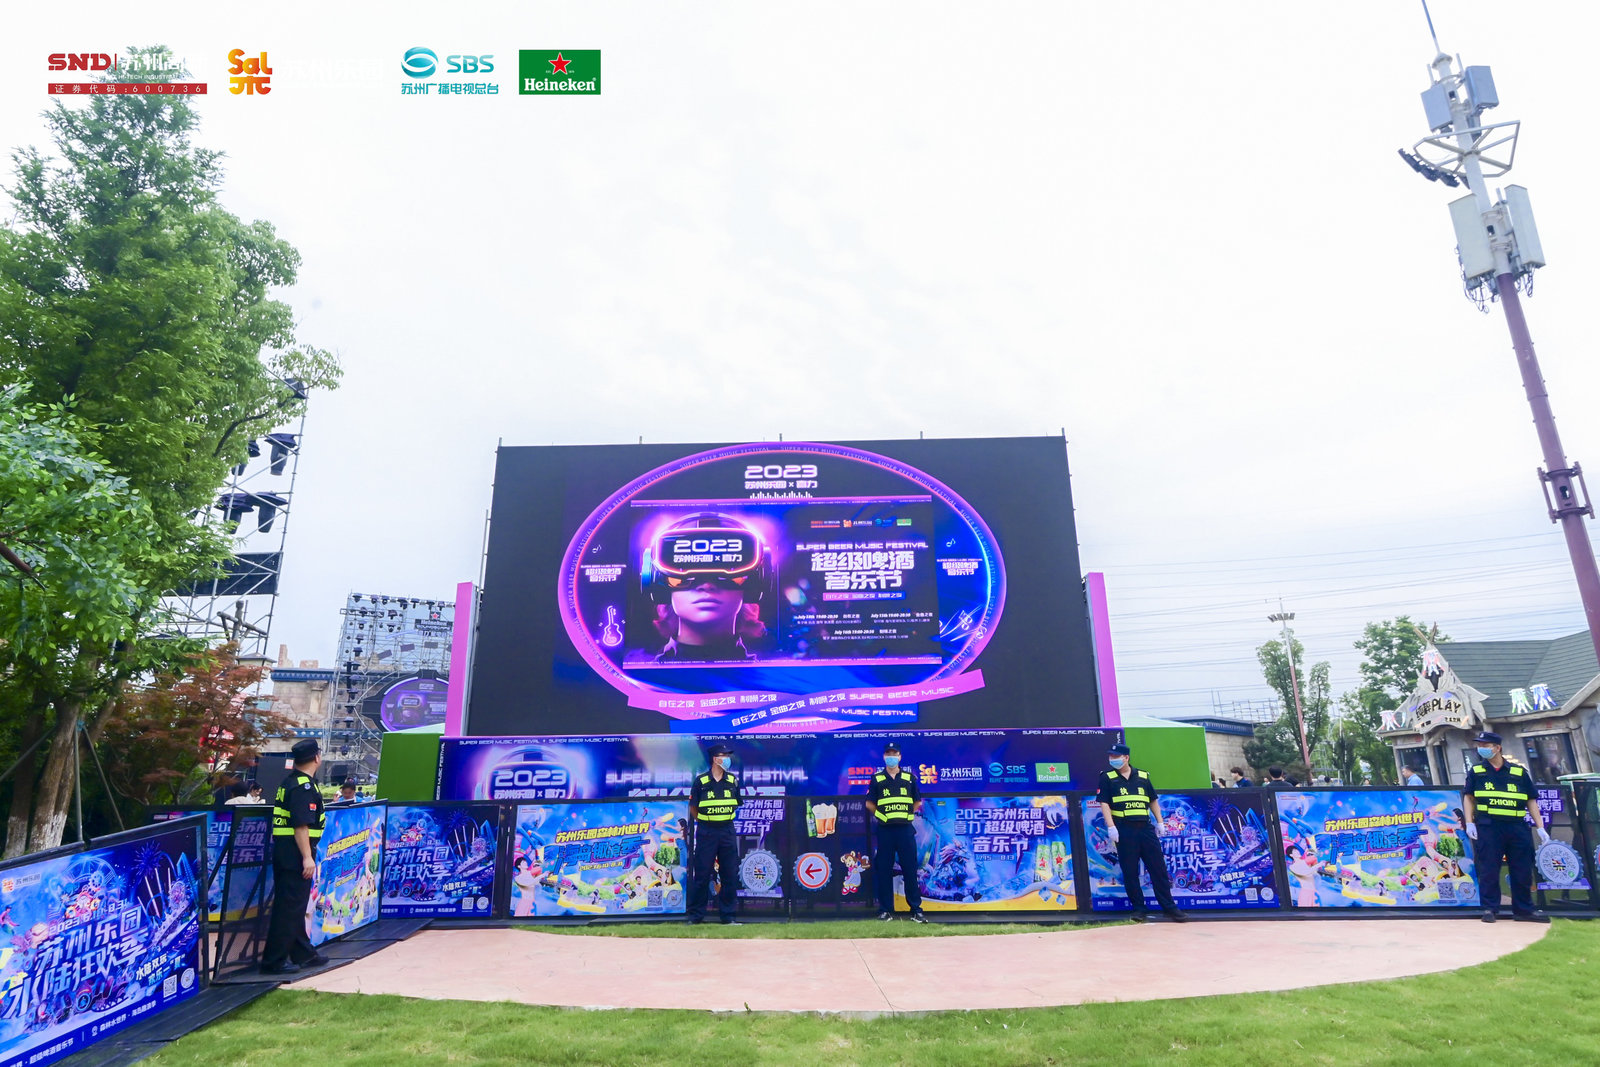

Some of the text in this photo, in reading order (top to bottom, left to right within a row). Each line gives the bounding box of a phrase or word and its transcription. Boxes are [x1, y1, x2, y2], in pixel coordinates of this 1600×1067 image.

[744, 465, 818, 479] 2023
[674, 539, 742, 553] 2023
[855, 542, 884, 550] MUSIC
[885, 541, 928, 549] FESTIVAL
[811, 551, 914, 571] 超级啤酒
[824, 570, 902, 590] 音乐节
[850, 692, 884, 700] SUPER
[888, 690, 917, 699] BEER
[922, 686, 956, 696] MUSIC
[842, 708, 870, 716] MUSIC
[606, 773, 651, 784] SUPER
[743, 770, 808, 781] FESTIVAL
[848, 767, 874, 775] SND
[940, 768, 982, 778] 苏州乐园
[1006, 766, 1026, 774] SBS
[495, 770, 566, 787] 2023
[844, 802, 862, 810] 14th
[884, 804, 909, 812] ZHIQIN
[1489, 798, 1517, 807] ZHIQIN
[707, 806, 733, 814] ZHIQIN
[738, 808, 784, 820] 超级啤酒
[955, 808, 1042, 820] 2023苏州乐园
[954, 820, 1044, 835] 喜力 超级啤酒
[1324, 811, 1424, 832] 苏州乐园森林水世界
[556, 822, 650, 844] 苏州乐园森林水世界
[973, 836, 1029, 855] 音乐节
[1160, 835, 1218, 853] 州乐园
[384, 846, 450, 866] 苏州乐园
[36, 904, 142, 969] 苏州乐园
[1, 927, 150, 1020] 水陆狂欢季
[136, 954, 168, 981] 水陆双玩
